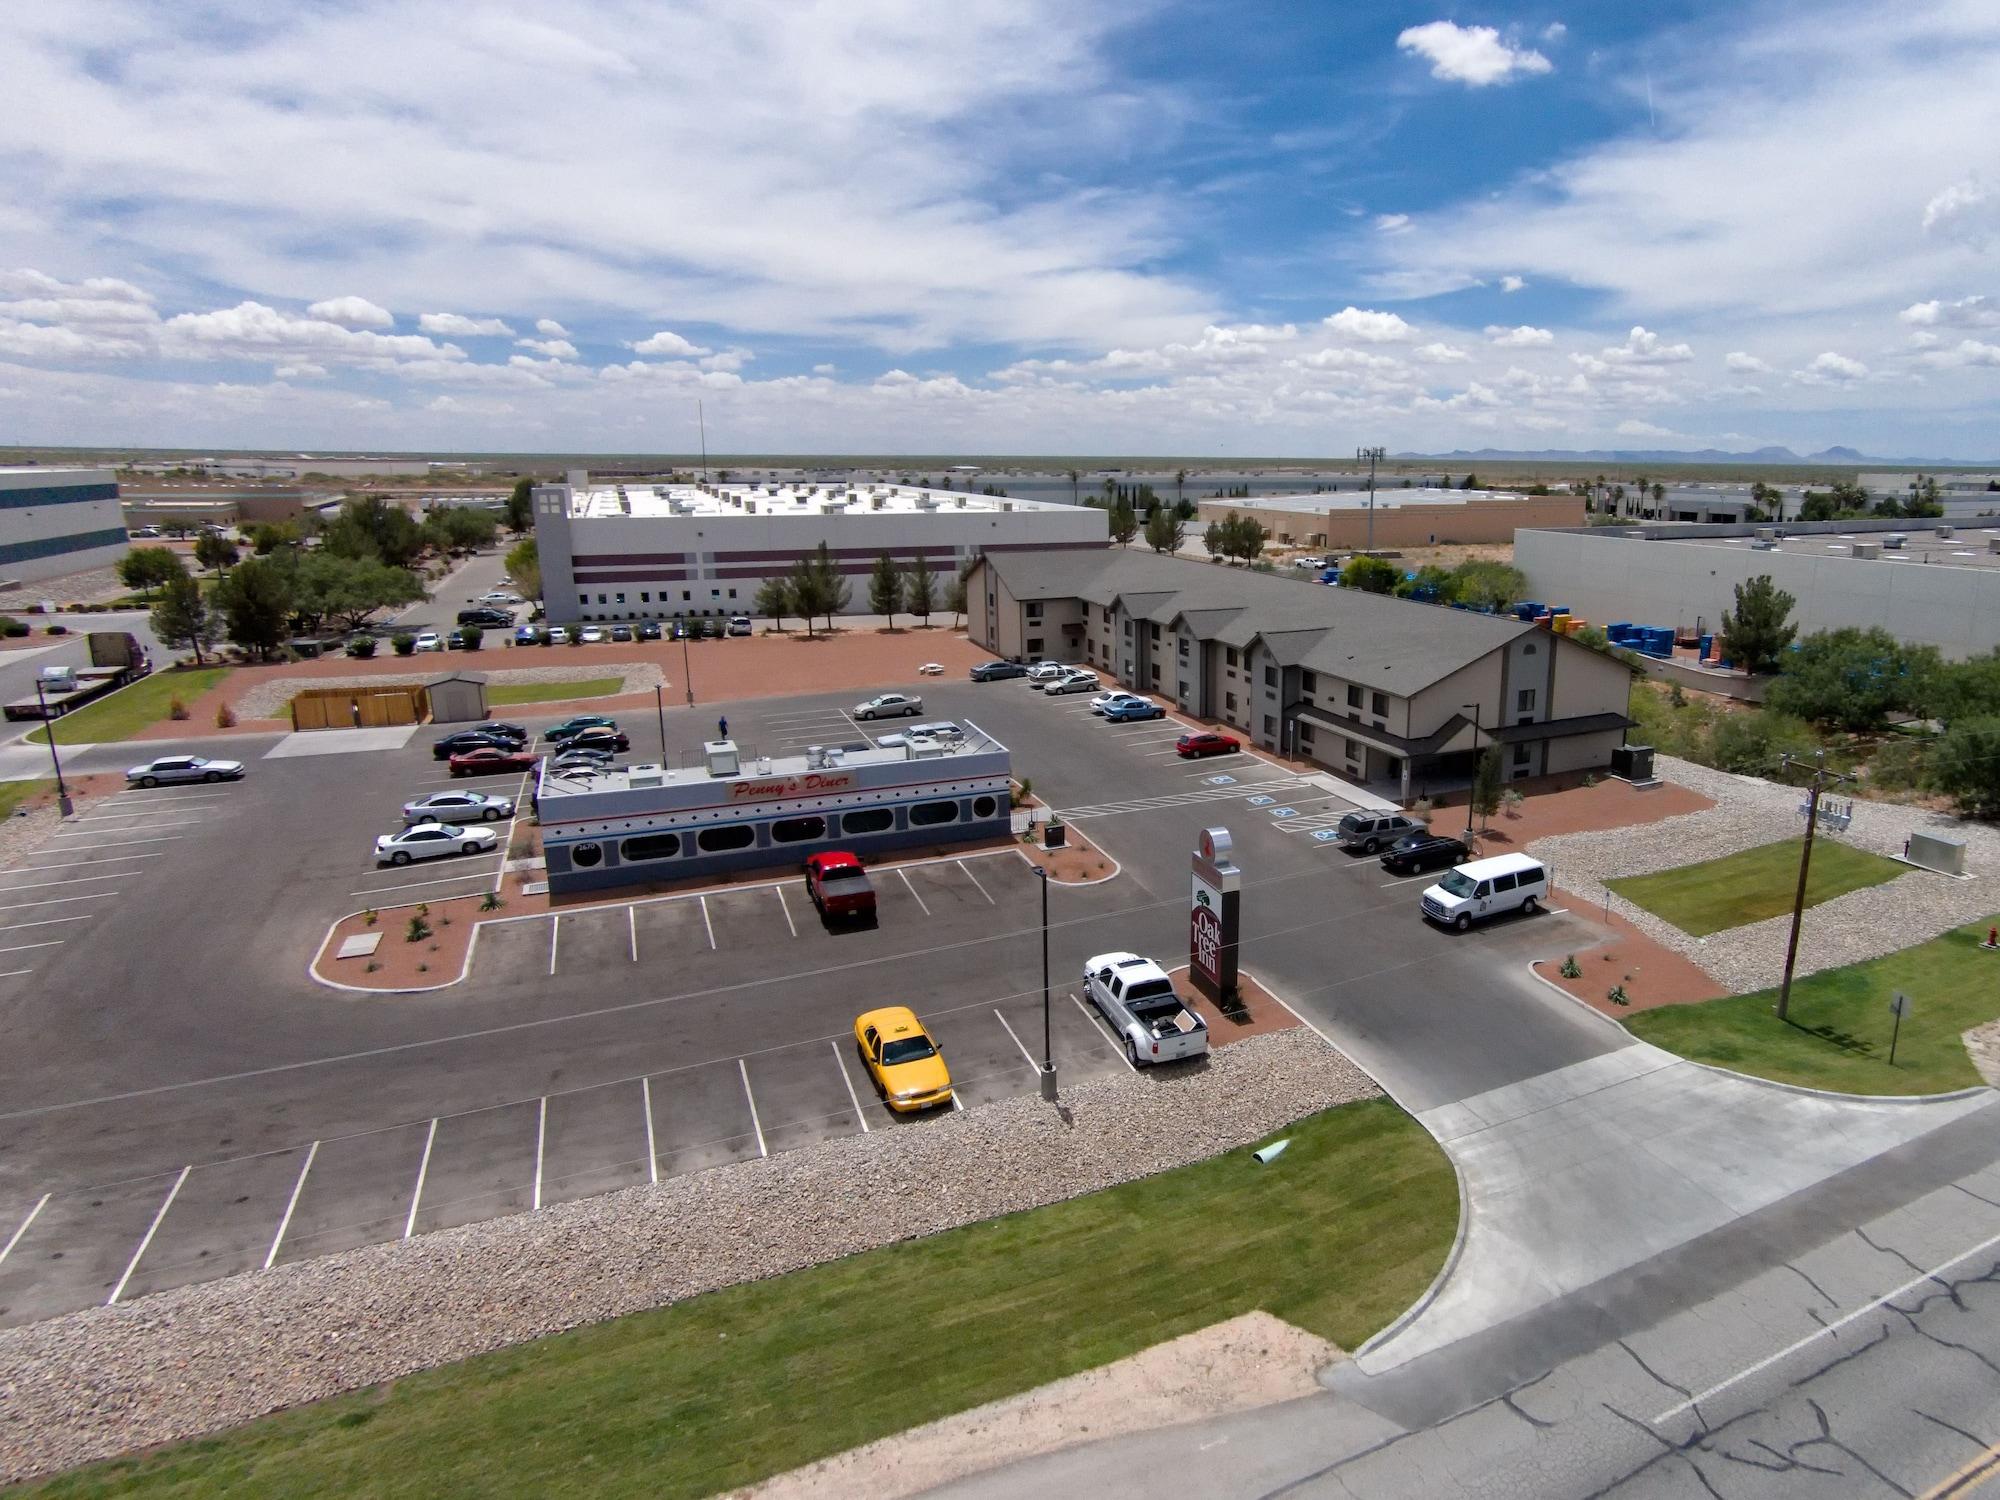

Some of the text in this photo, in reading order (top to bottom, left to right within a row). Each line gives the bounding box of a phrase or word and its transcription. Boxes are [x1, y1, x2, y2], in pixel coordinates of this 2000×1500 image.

[734, 774, 849, 797] Penny's Diner
[1193, 921, 1216, 957] Tree
[1199, 912, 1220, 946] Oak
[1198, 946, 1216, 974] Inn
